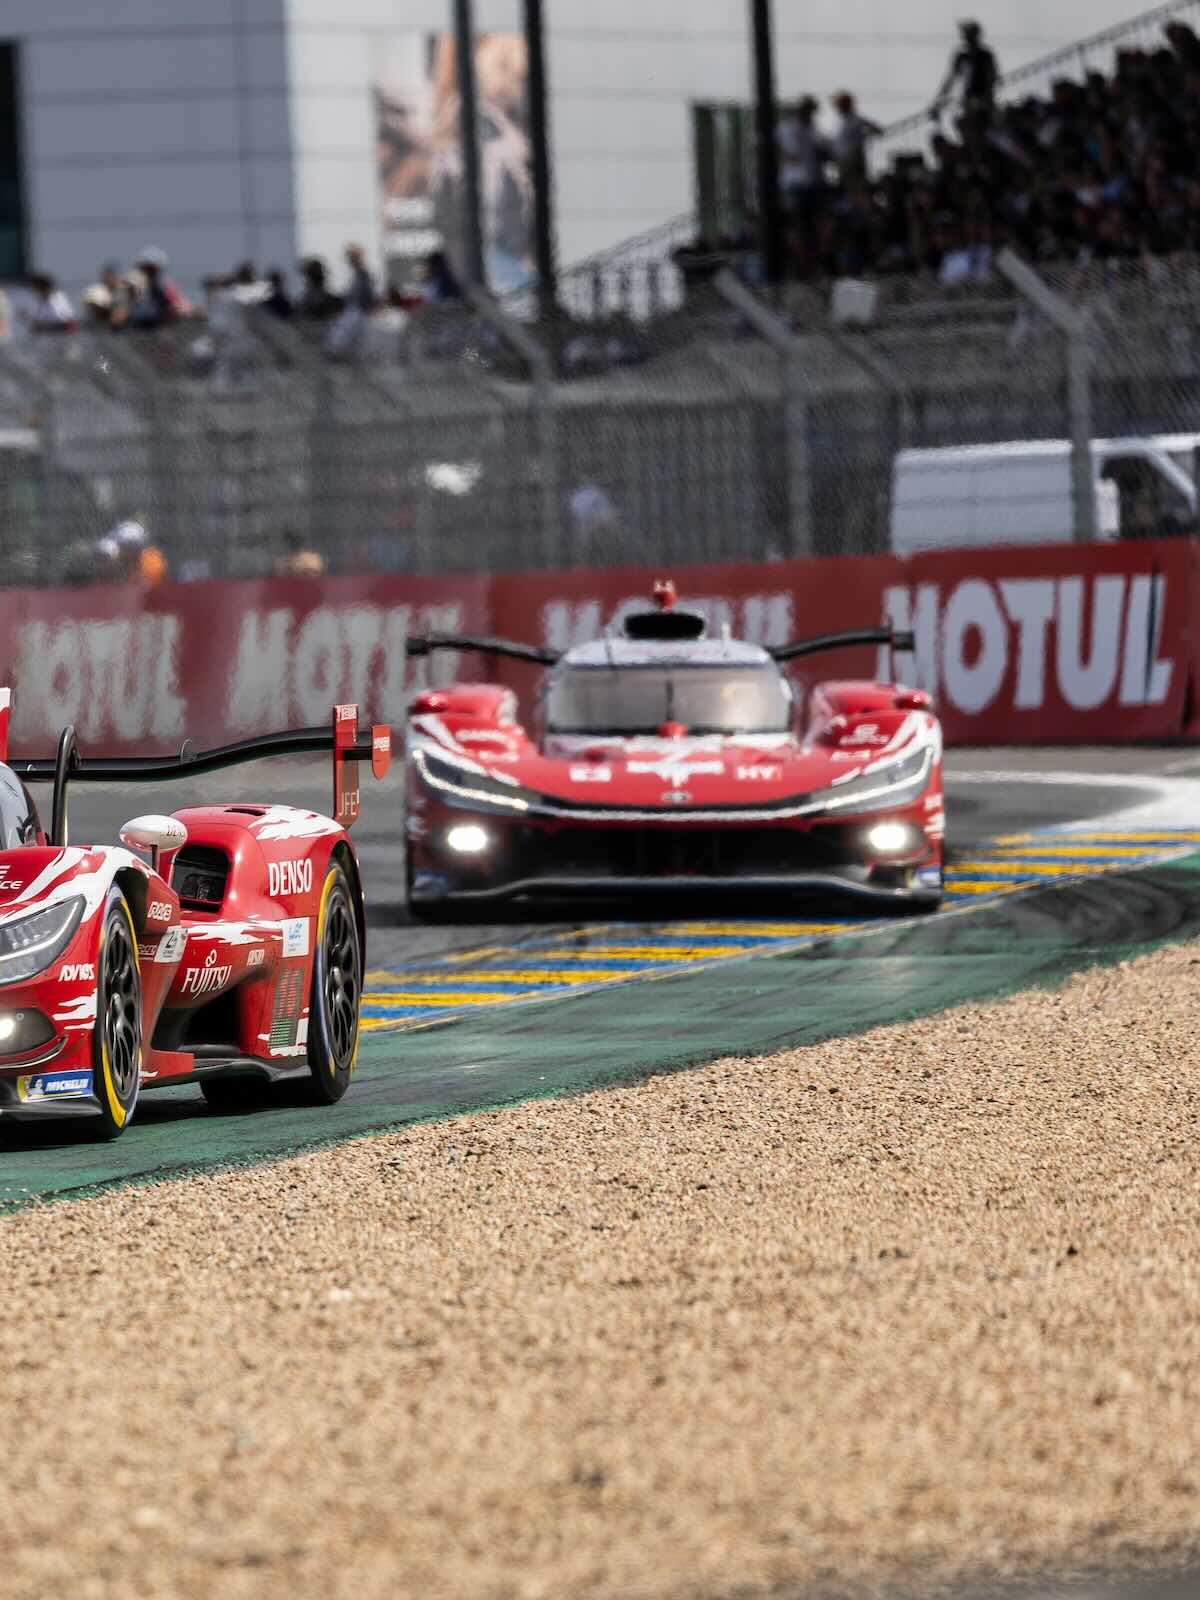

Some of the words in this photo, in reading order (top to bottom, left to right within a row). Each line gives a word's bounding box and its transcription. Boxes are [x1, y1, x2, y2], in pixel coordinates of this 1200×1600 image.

[880, 573, 1173, 714] MOTUL
[338, 791, 358, 817] JFE
[268, 859, 313, 897] DENSO
[180, 965, 233, 1000] FUJITSU
[45, 1078, 89, 1092] MICHELIN
